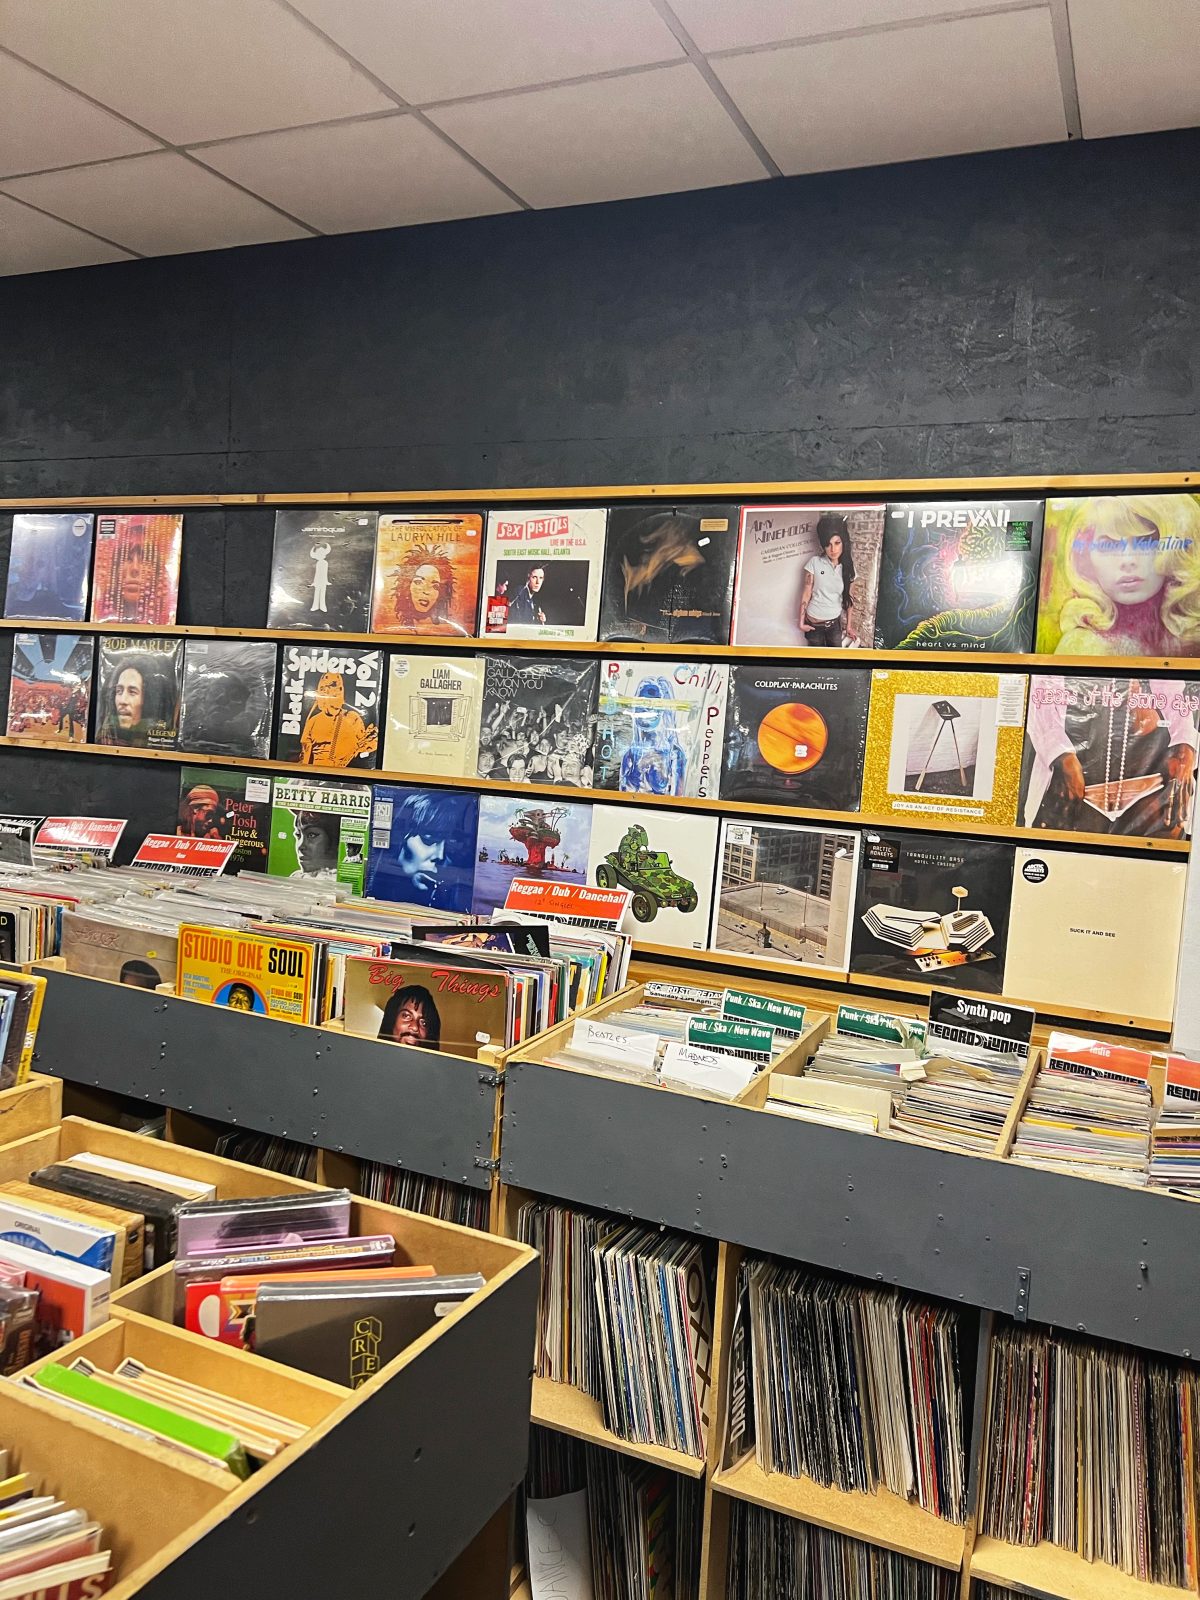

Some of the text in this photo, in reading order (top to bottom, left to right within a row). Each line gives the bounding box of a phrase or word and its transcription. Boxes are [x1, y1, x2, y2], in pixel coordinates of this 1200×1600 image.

[907, 508, 1010, 528] I PREVAIL
[391, 532, 461, 542] LAURYN HILL
[754, 522, 812, 545] WINEHOUSE
[104, 639, 127, 650] BOB
[916, 640, 942, 648] heart
[961, 641, 986, 649] mind
[287, 648, 357, 679] Spiders
[354, 650, 379, 708] Vol 2
[432, 669, 450, 679] LIAM
[420, 678, 462, 690] GALLAGHER
[521, 679, 543, 690] YOU
[281, 678, 304, 735] Black
[275, 787, 317, 803] BETTY
[320, 792, 371, 808] HARRIS
[225, 798, 254, 814] Peter
[945, 807, 982, 815] RESISTANCE
[232, 813, 257, 829] Tosh
[231, 827, 258, 839] Live &
[144, 837, 170, 849] Reggae
[175, 840, 190, 850] Dub
[195, 841, 233, 854] Dancehall
[906, 851, 946, 861] TRANQUILITY
[510, 881, 544, 894] Reggae
[552, 885, 571, 897] Dub
[578, 889, 626, 904] Dancehall
[184, 932, 233, 966] STUDIO
[237, 941, 264, 971] ONE
[268, 947, 304, 978] SOUL
[220, 967, 264, 980] THE ORIGINAL
[367, 963, 405, 993] Big
[431, 970, 502, 1003] Things
[726, 994, 743, 1005] Punk
[748, 998, 762, 1009] Ska
[767, 1002, 783, 1012] New
[783, 1006, 802, 1019] Wave
[956, 999, 1012, 1025] Synth pop
[840, 1009, 860, 1022] Punk
[689, 1019, 707, 1031] Punk
[713, 1022, 727, 1034] Ska
[734, 1025, 749, 1036] New
[750, 1027, 771, 1038] Wave
[909, 1026, 923, 1035] ave
[1089, 1046, 1111, 1057] Indie
[14, 1220, 41, 1235] ORIGINAL
[730, 1360, 746, 1444] DANCE
